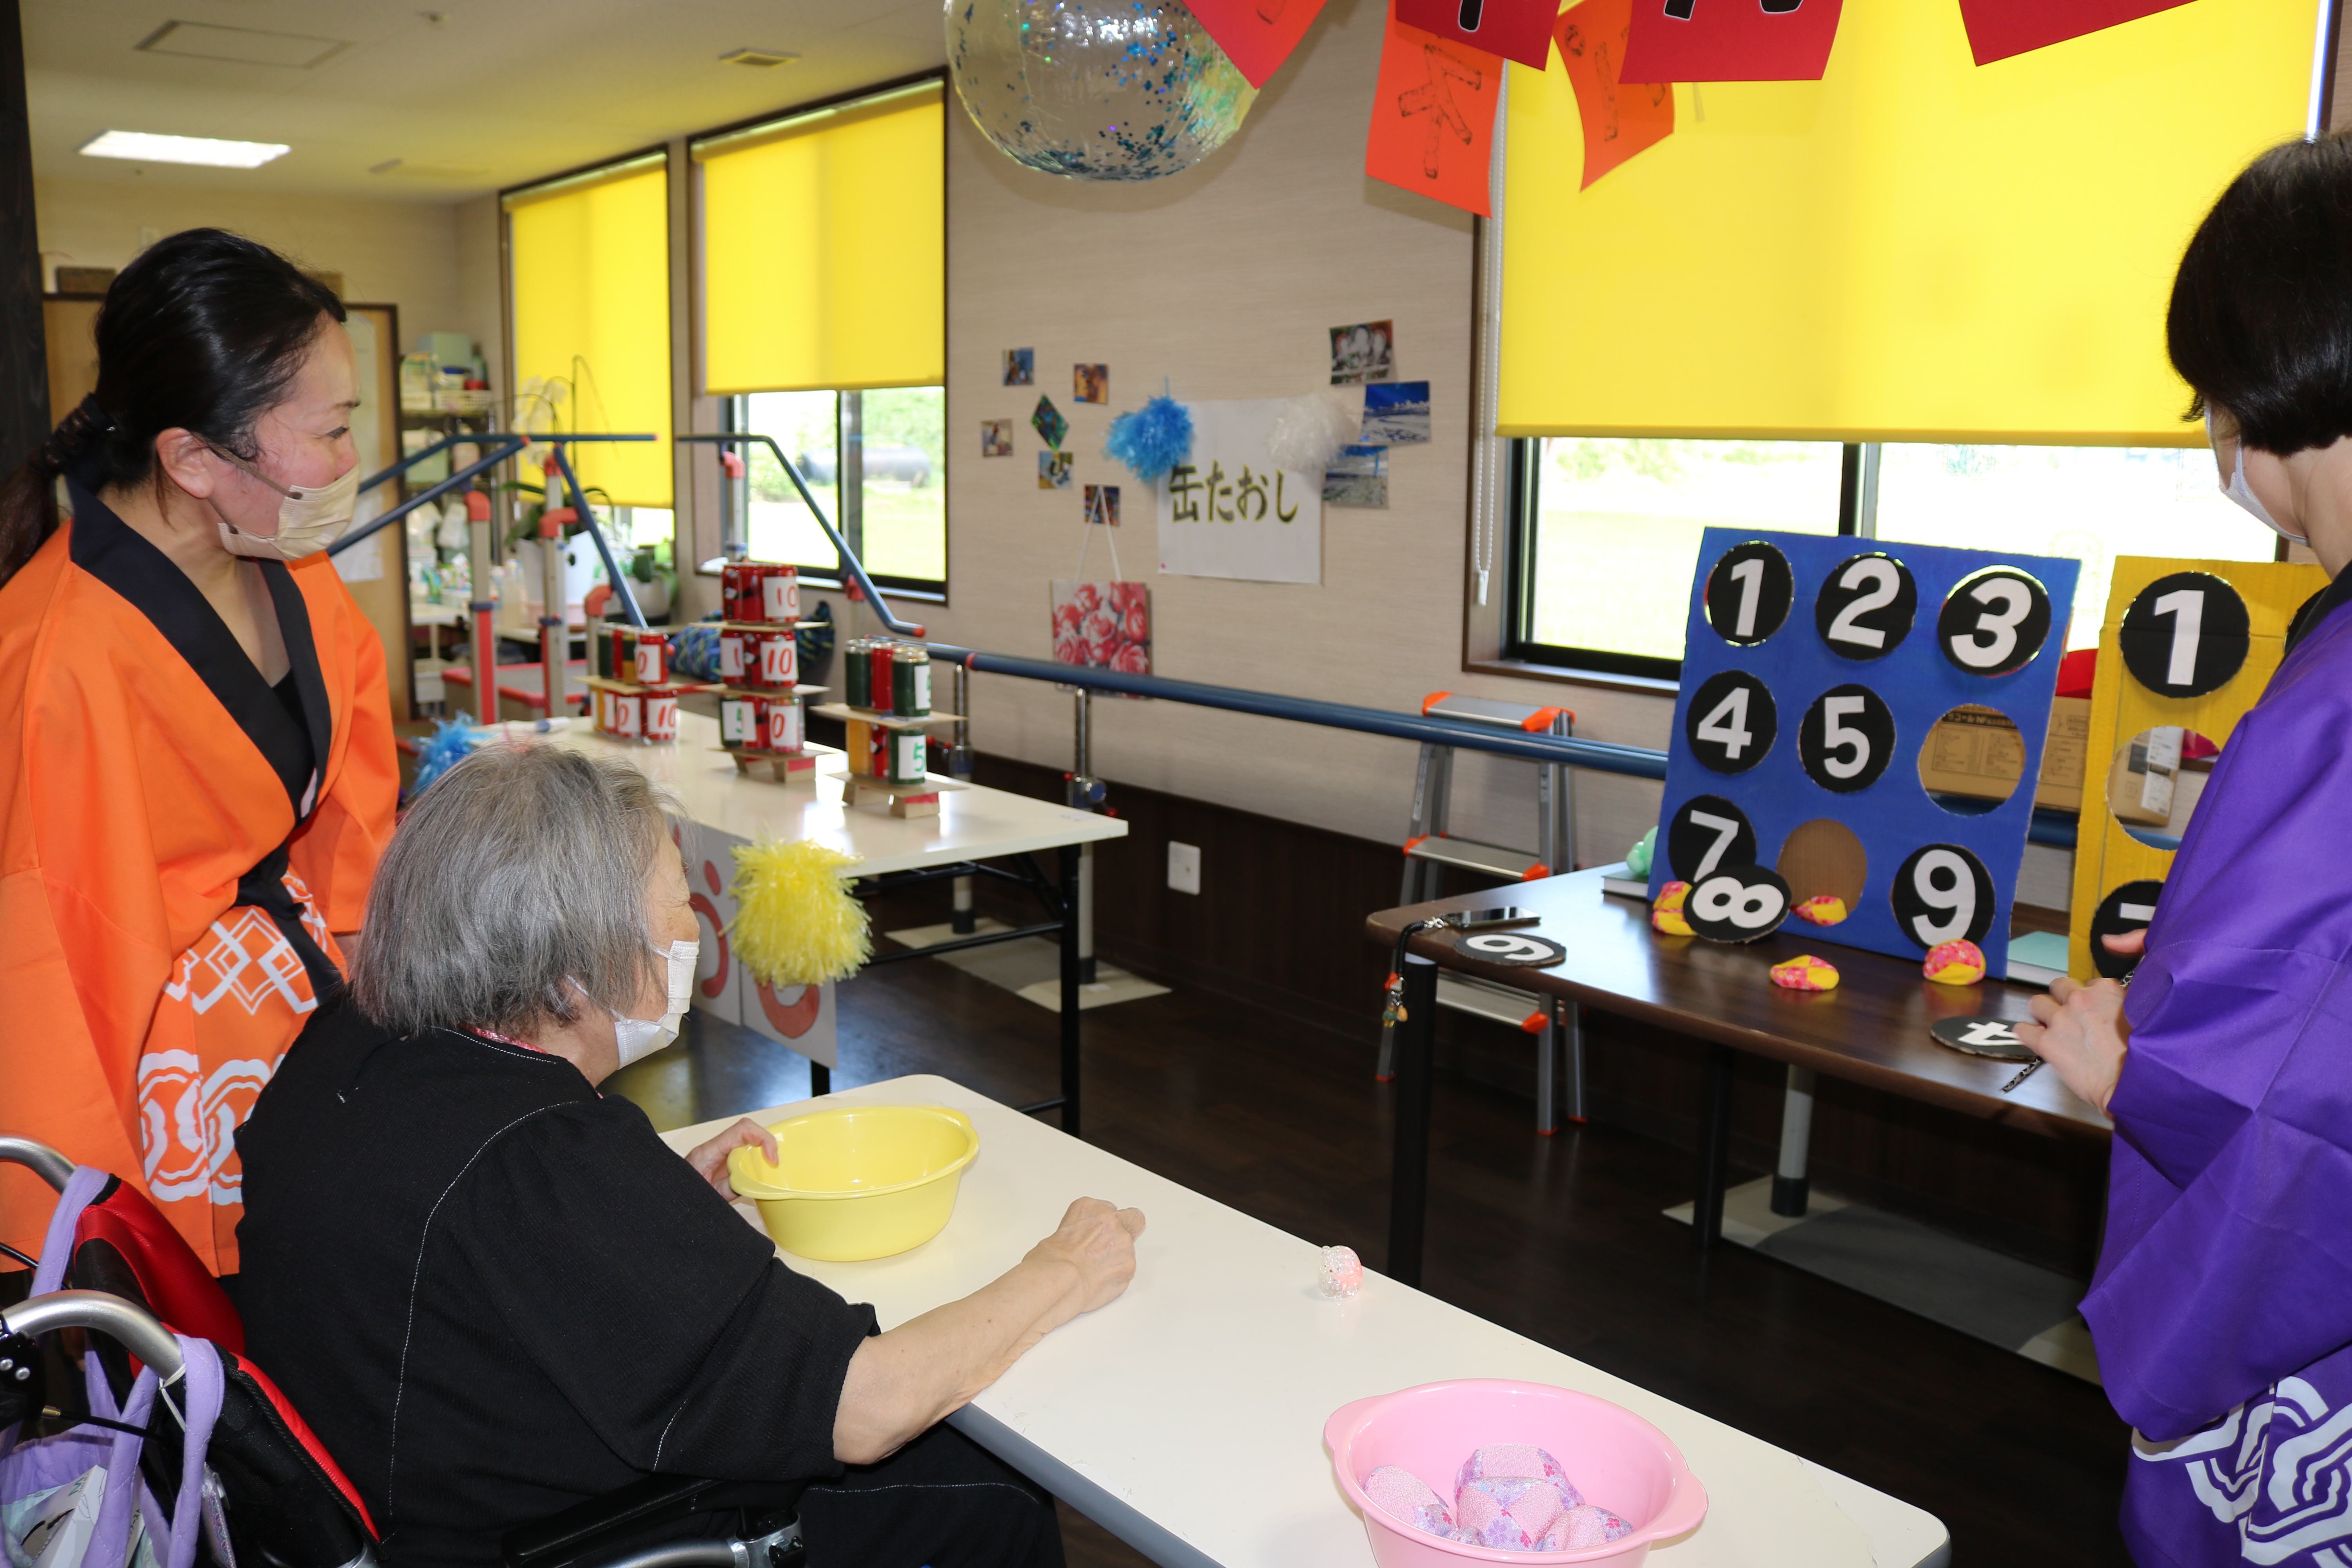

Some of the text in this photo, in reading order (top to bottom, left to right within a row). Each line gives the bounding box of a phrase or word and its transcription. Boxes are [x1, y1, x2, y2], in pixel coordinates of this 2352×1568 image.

[1168, 460, 1299, 524] 缶たおし
[777, 585, 798, 608] 10
[1731, 557, 2032, 667] 1 2 3
[767, 648, 792, 674] 10
[2154, 590, 2204, 686] 1
[913, 742, 926, 772] 5
[1697, 687, 1752, 759] 4
[1824, 695, 1870, 778] 5
[1689, 810, 1739, 882] 7
[1691, 876, 1784, 928] 8
[1911, 849, 1976, 946] 9
